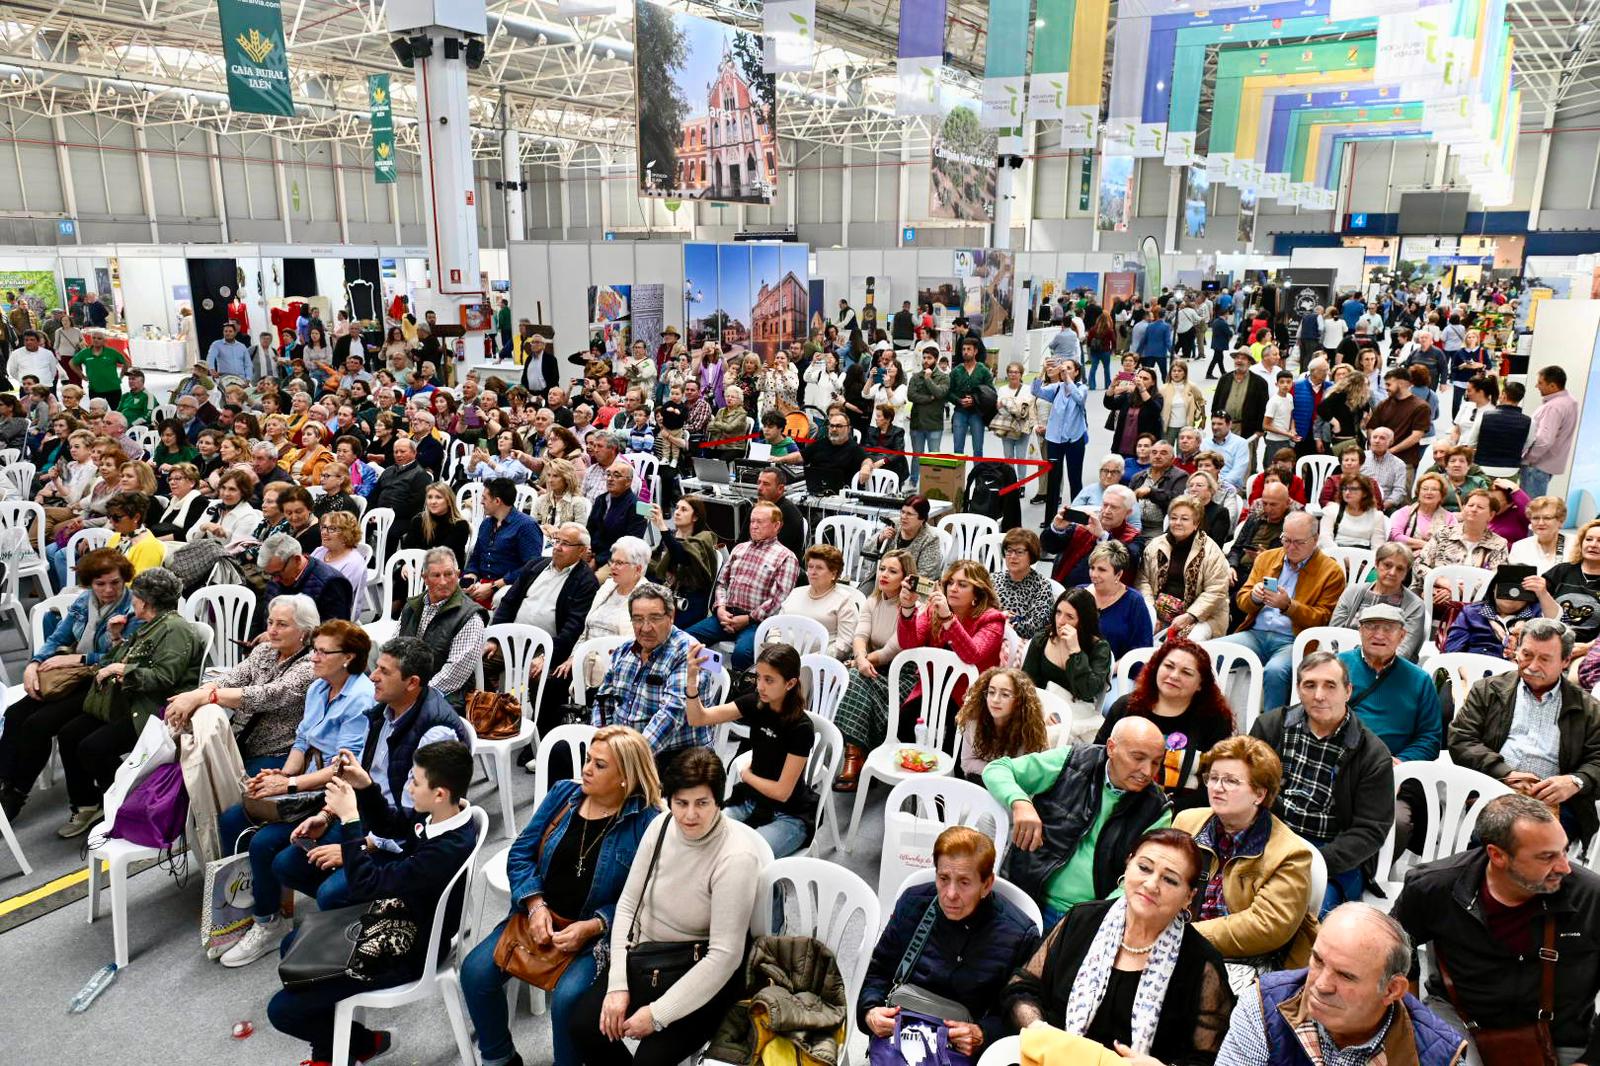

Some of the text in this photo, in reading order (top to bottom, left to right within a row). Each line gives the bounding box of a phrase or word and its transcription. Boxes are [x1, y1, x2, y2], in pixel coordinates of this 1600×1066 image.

[255, 68, 286, 80] RURAL
[1355, 214, 1363, 226] 4
[61, 222, 73, 233] 10
[906, 230, 913, 240] 6
